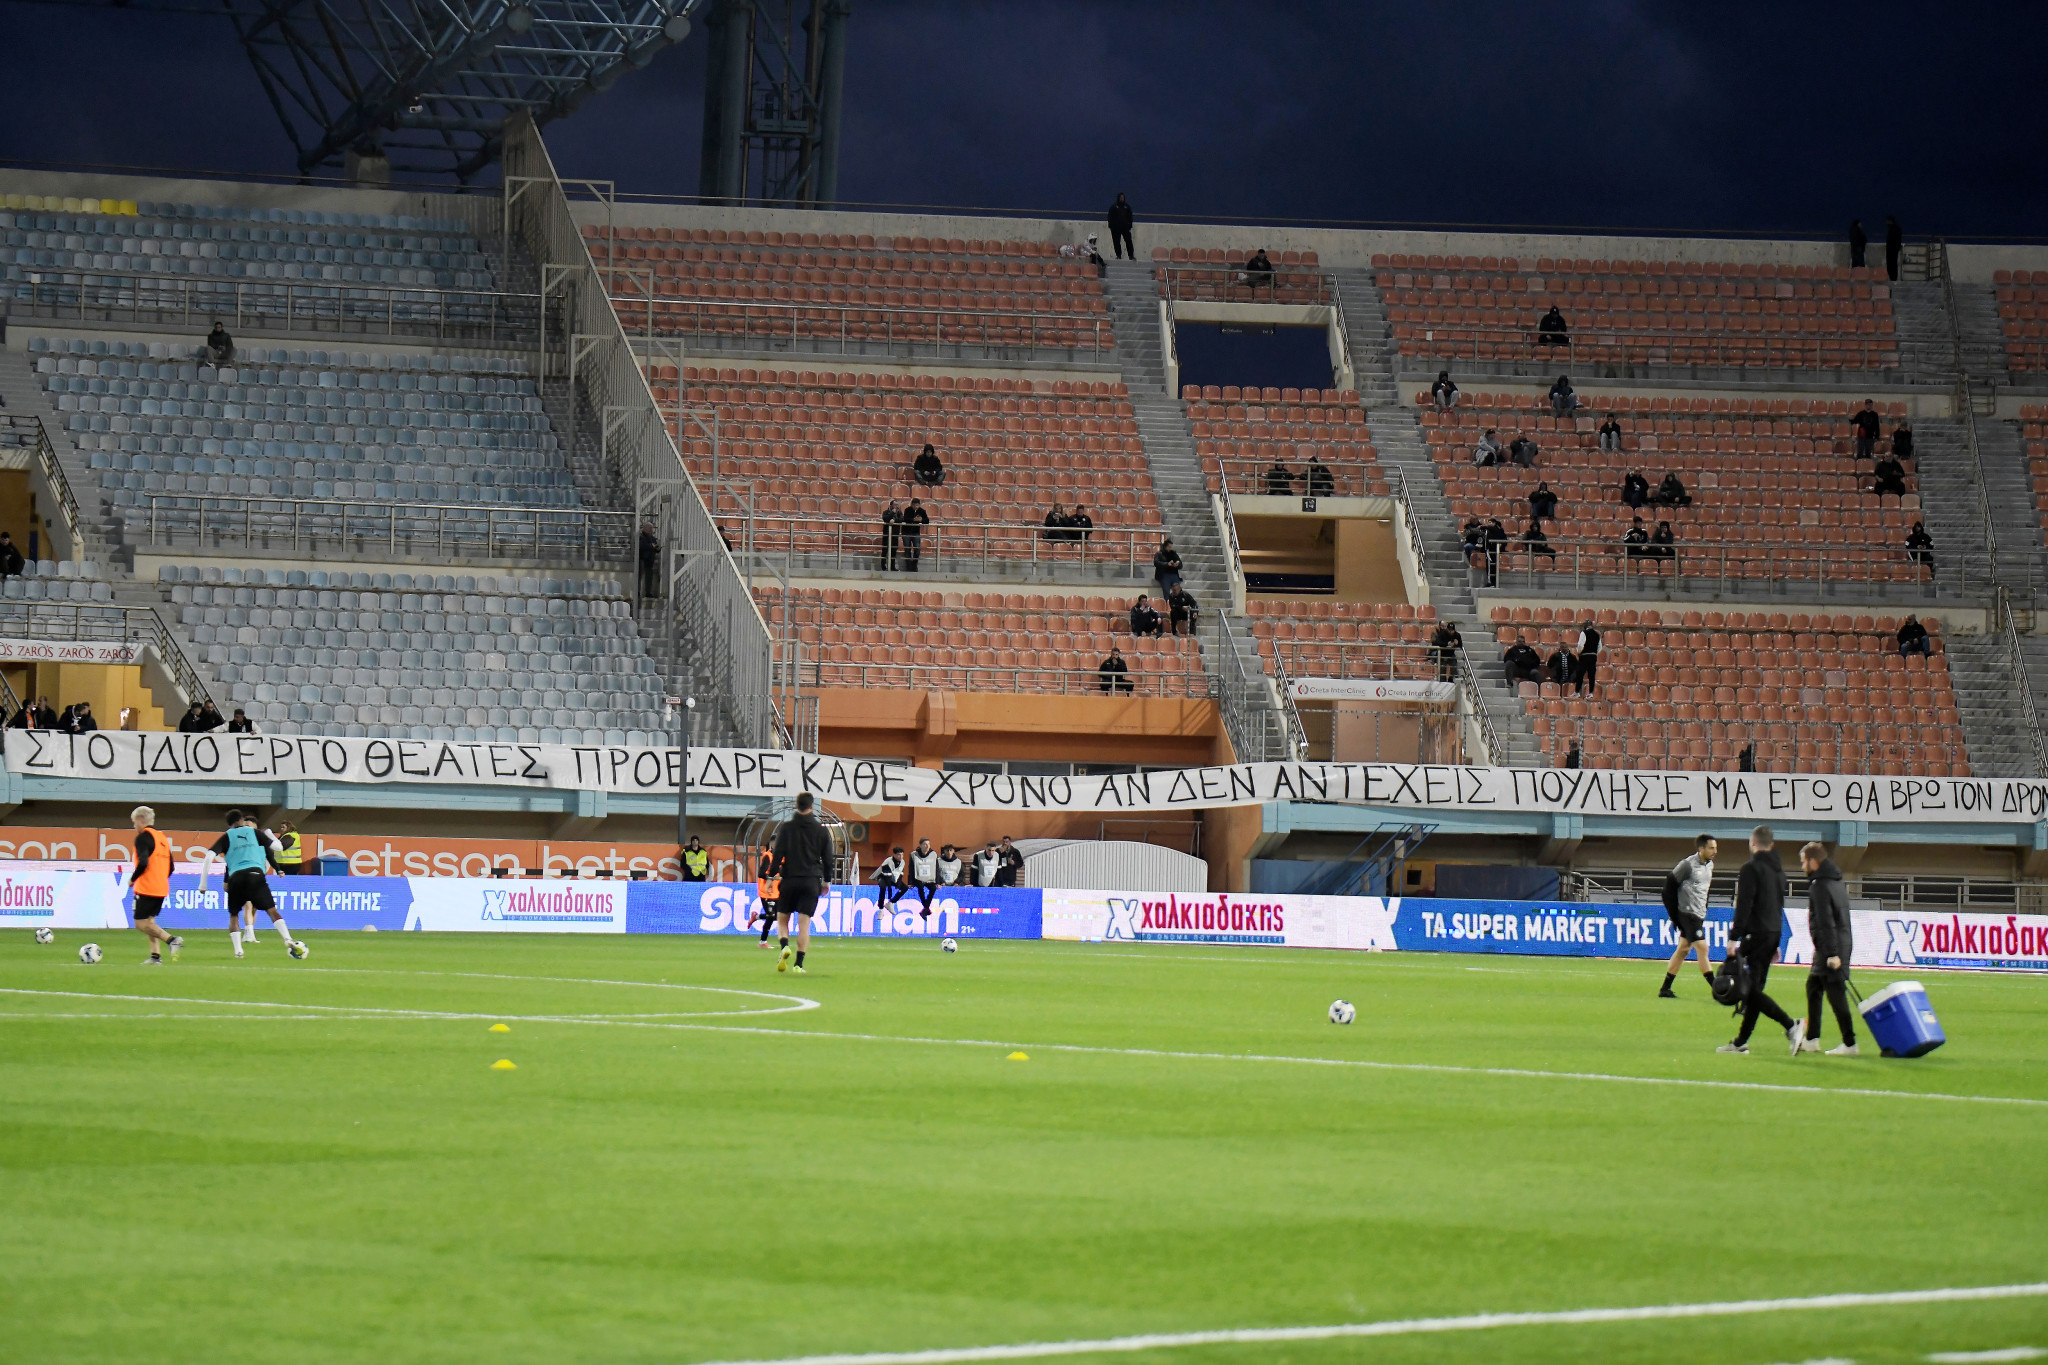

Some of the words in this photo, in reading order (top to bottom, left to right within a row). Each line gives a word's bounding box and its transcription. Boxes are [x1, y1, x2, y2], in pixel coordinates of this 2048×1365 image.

[25, 730, 114, 769] ΣΤΟ
[138, 734, 220, 774] ΙΔΙΟ
[236, 737, 347, 775] ΕΡΓΟ
[365, 740, 548, 778] ΘΕΑΤΕΣ
[571, 748, 786, 789] ΠΡΟΕΔΡΕ
[800, 755, 909, 802] ΚΑΘΕ
[925, 770, 1071, 808] ΧΡΟΝΟ
[1095, 774, 1150, 806] ΑΝ
[1168, 766, 1255, 802] ΔΕΝ
[1273, 765, 1495, 804] ΑΝΤΕΧΕΙΣ
[1509, 770, 1691, 812] ΠΟΥΛΗΣΕ
[1706, 776, 1753, 812] ΜΑ
[1769, 778, 1832, 811] ΕΓΩ
[1845, 781, 1880, 815] ΘΑ
[1890, 780, 1945, 814] ΒΡΩ
[1947, 781, 1991, 811] ΤΟΝ
[544, 846, 744, 882] betssn
[175, 890, 219, 910] SUPER
[291, 892, 320, 910] ΤΗΣ
[699, 886, 959, 934] Stximan
[1451, 912, 1518, 942] SUPER
[1524, 915, 1608, 944] MARKET
[1613, 917, 1654, 945] ΤΗΣ
[1660, 919, 1741, 949] ΚΤΗ
